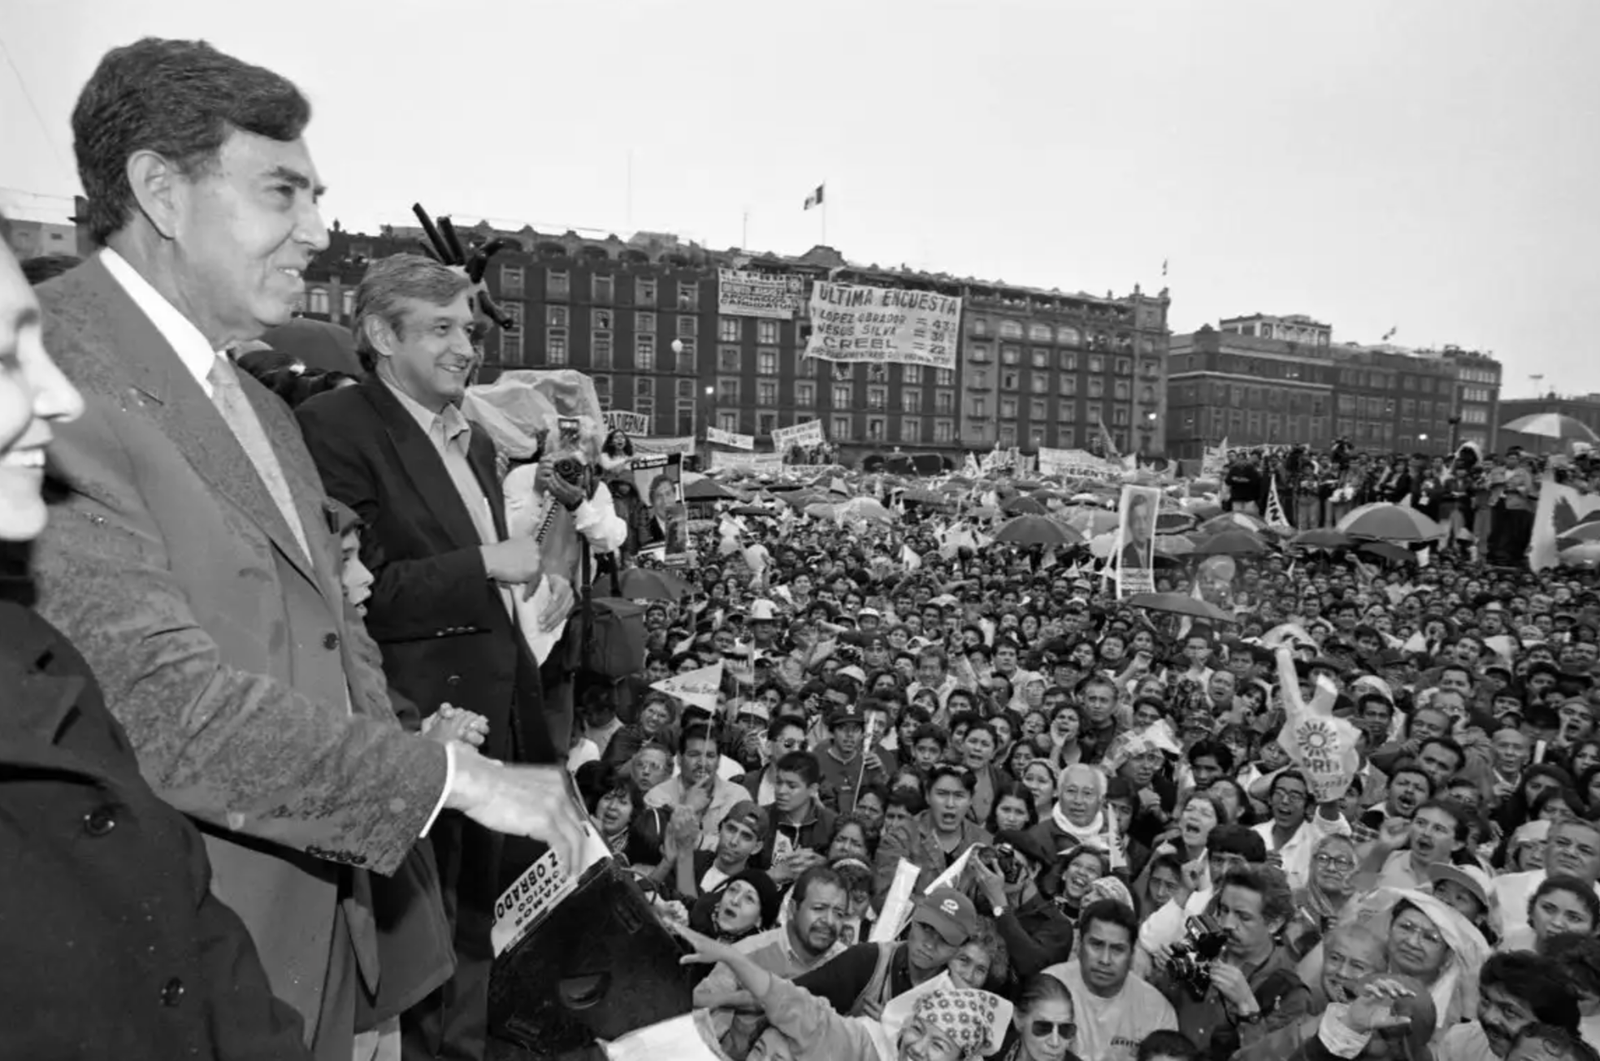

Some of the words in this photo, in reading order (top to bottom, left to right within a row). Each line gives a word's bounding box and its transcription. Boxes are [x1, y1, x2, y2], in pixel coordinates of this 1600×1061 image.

[819, 283, 873, 308] ULTIMA
[882, 289, 957, 316] ENCUESTA
[820, 309, 855, 324] LOPEZ
[862, 324, 897, 337] SILVA
[823, 336, 898, 349] CREEL
